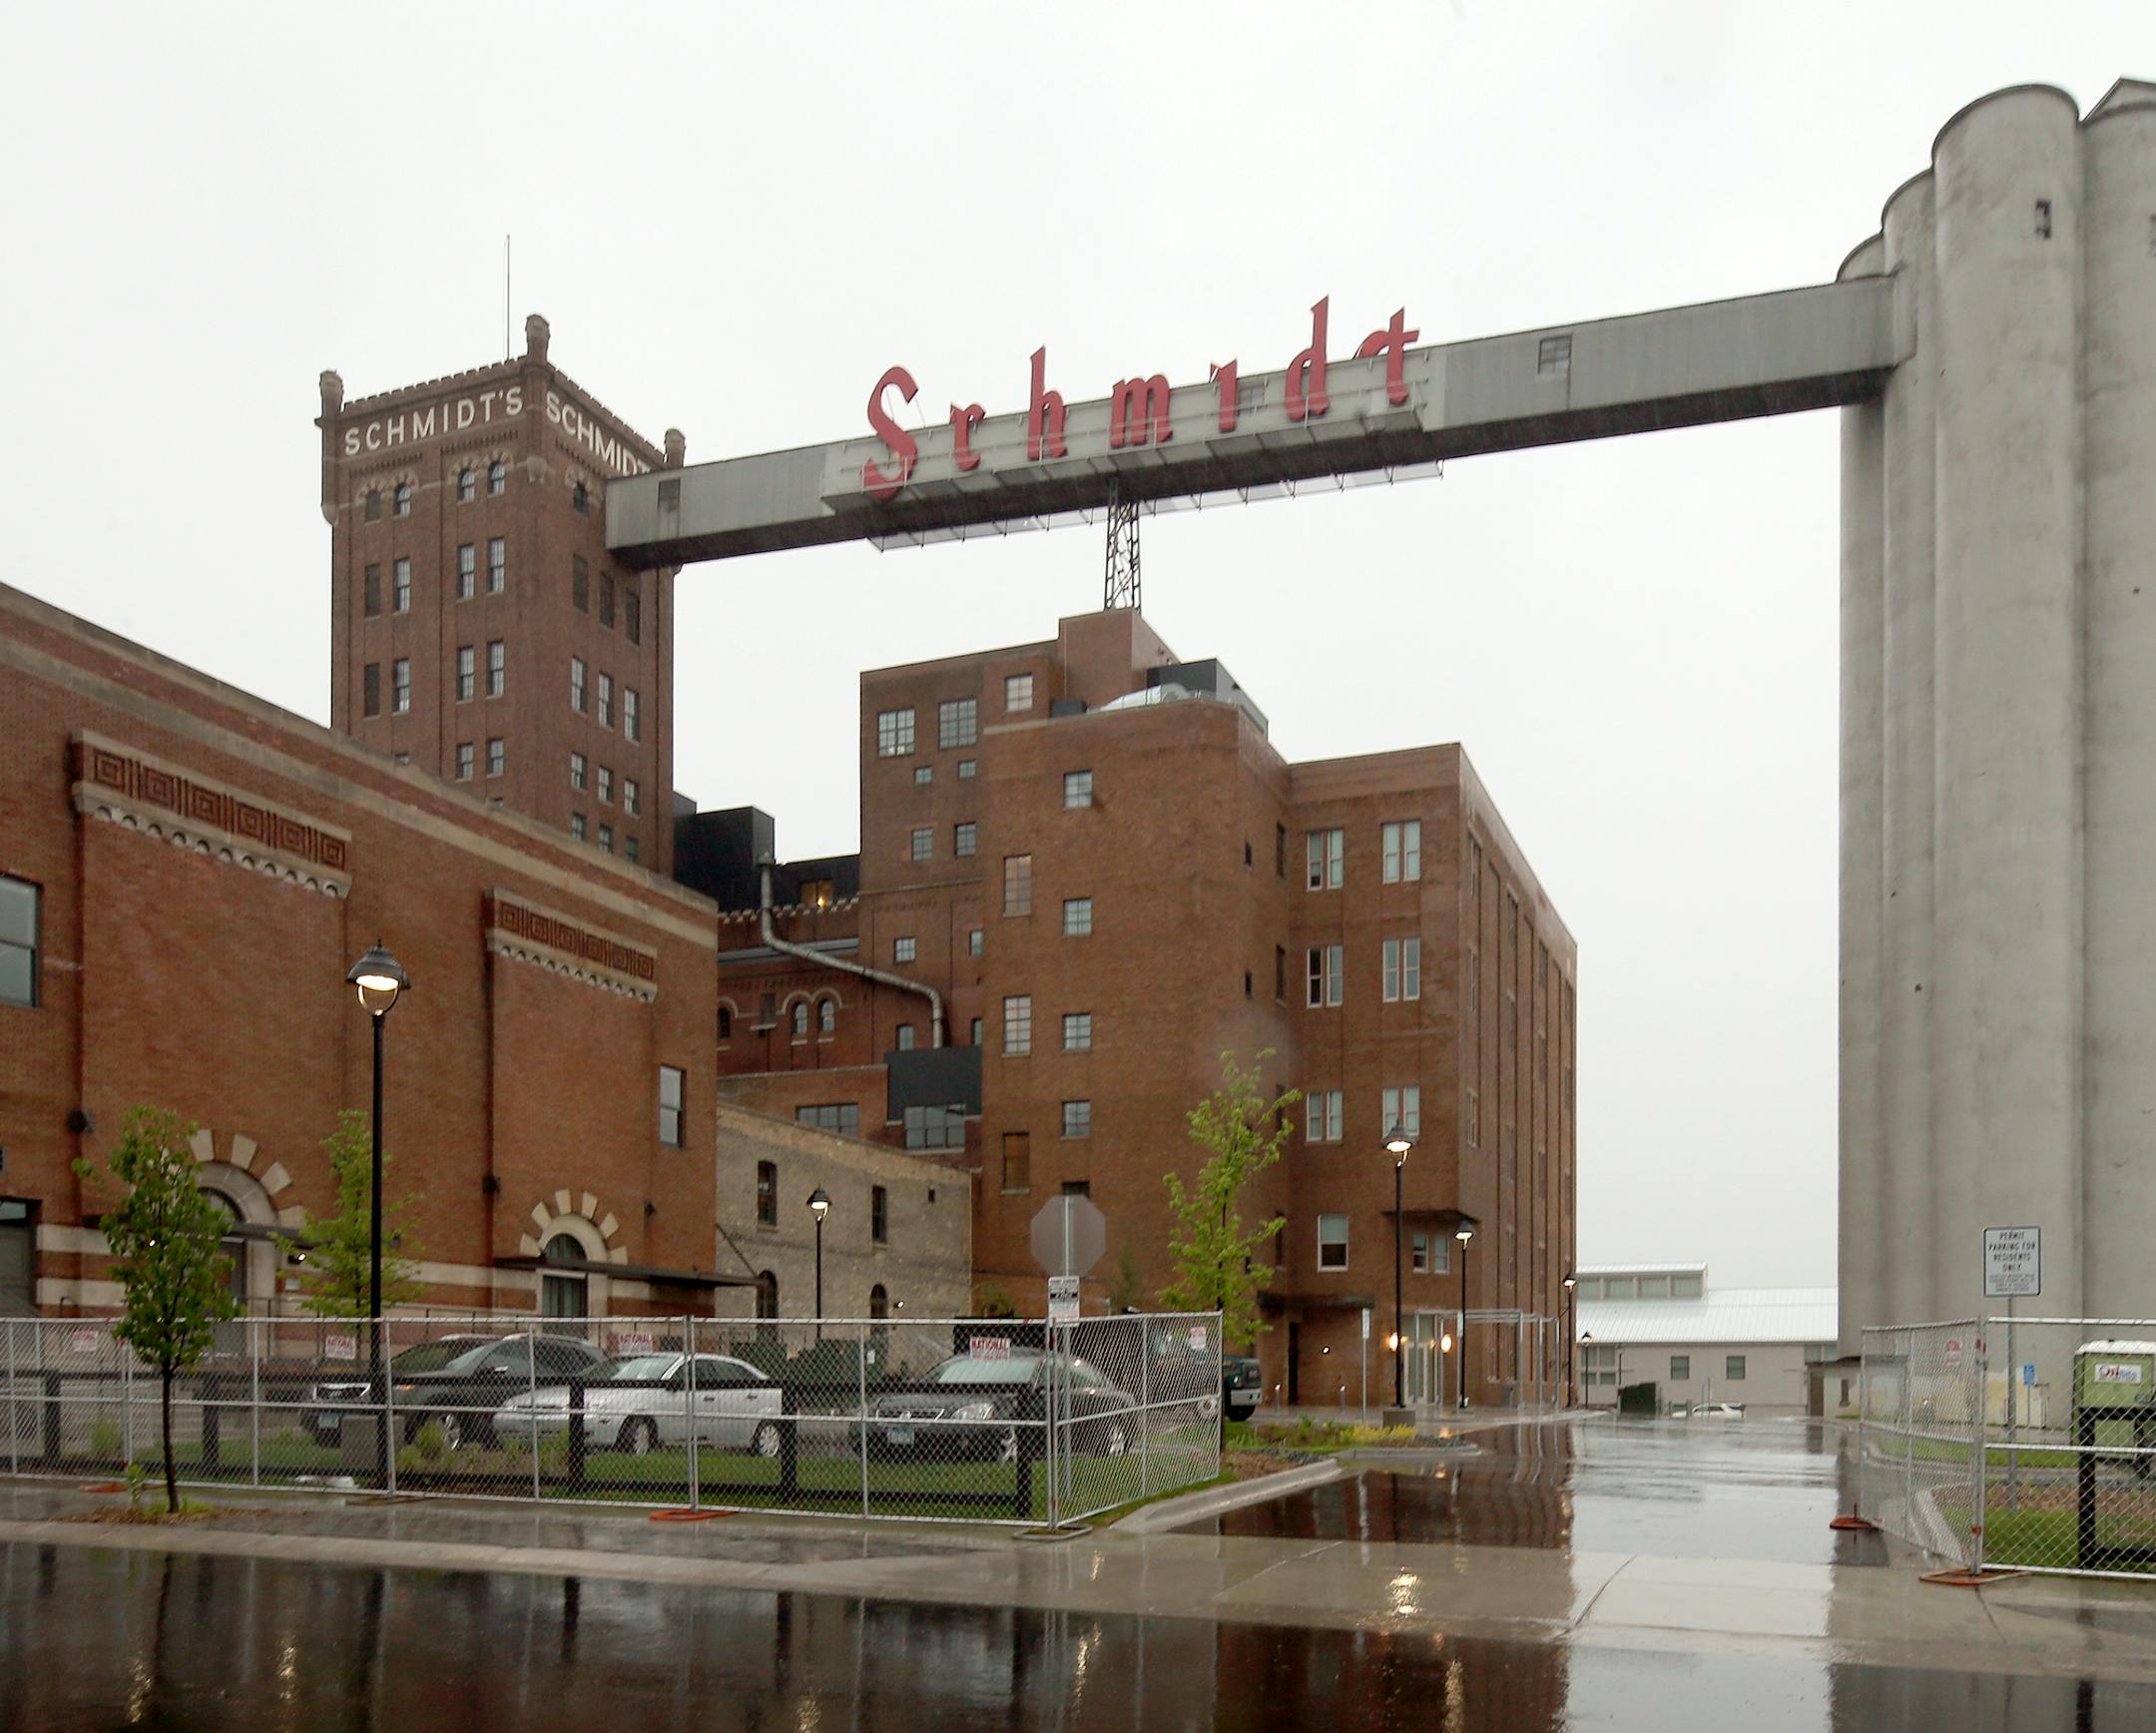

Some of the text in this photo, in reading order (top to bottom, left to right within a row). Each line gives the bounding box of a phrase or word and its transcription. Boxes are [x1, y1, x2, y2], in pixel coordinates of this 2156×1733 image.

[344, 386, 524, 456] SCHMIDT'S
[1999, 1231, 2025, 1240] PERMIT
[1993, 1252, 2031, 1261] RESIDENTS
[2002, 1263, 2022, 1272] ONLY
[971, 1340, 1007, 1350] NATIONAL
